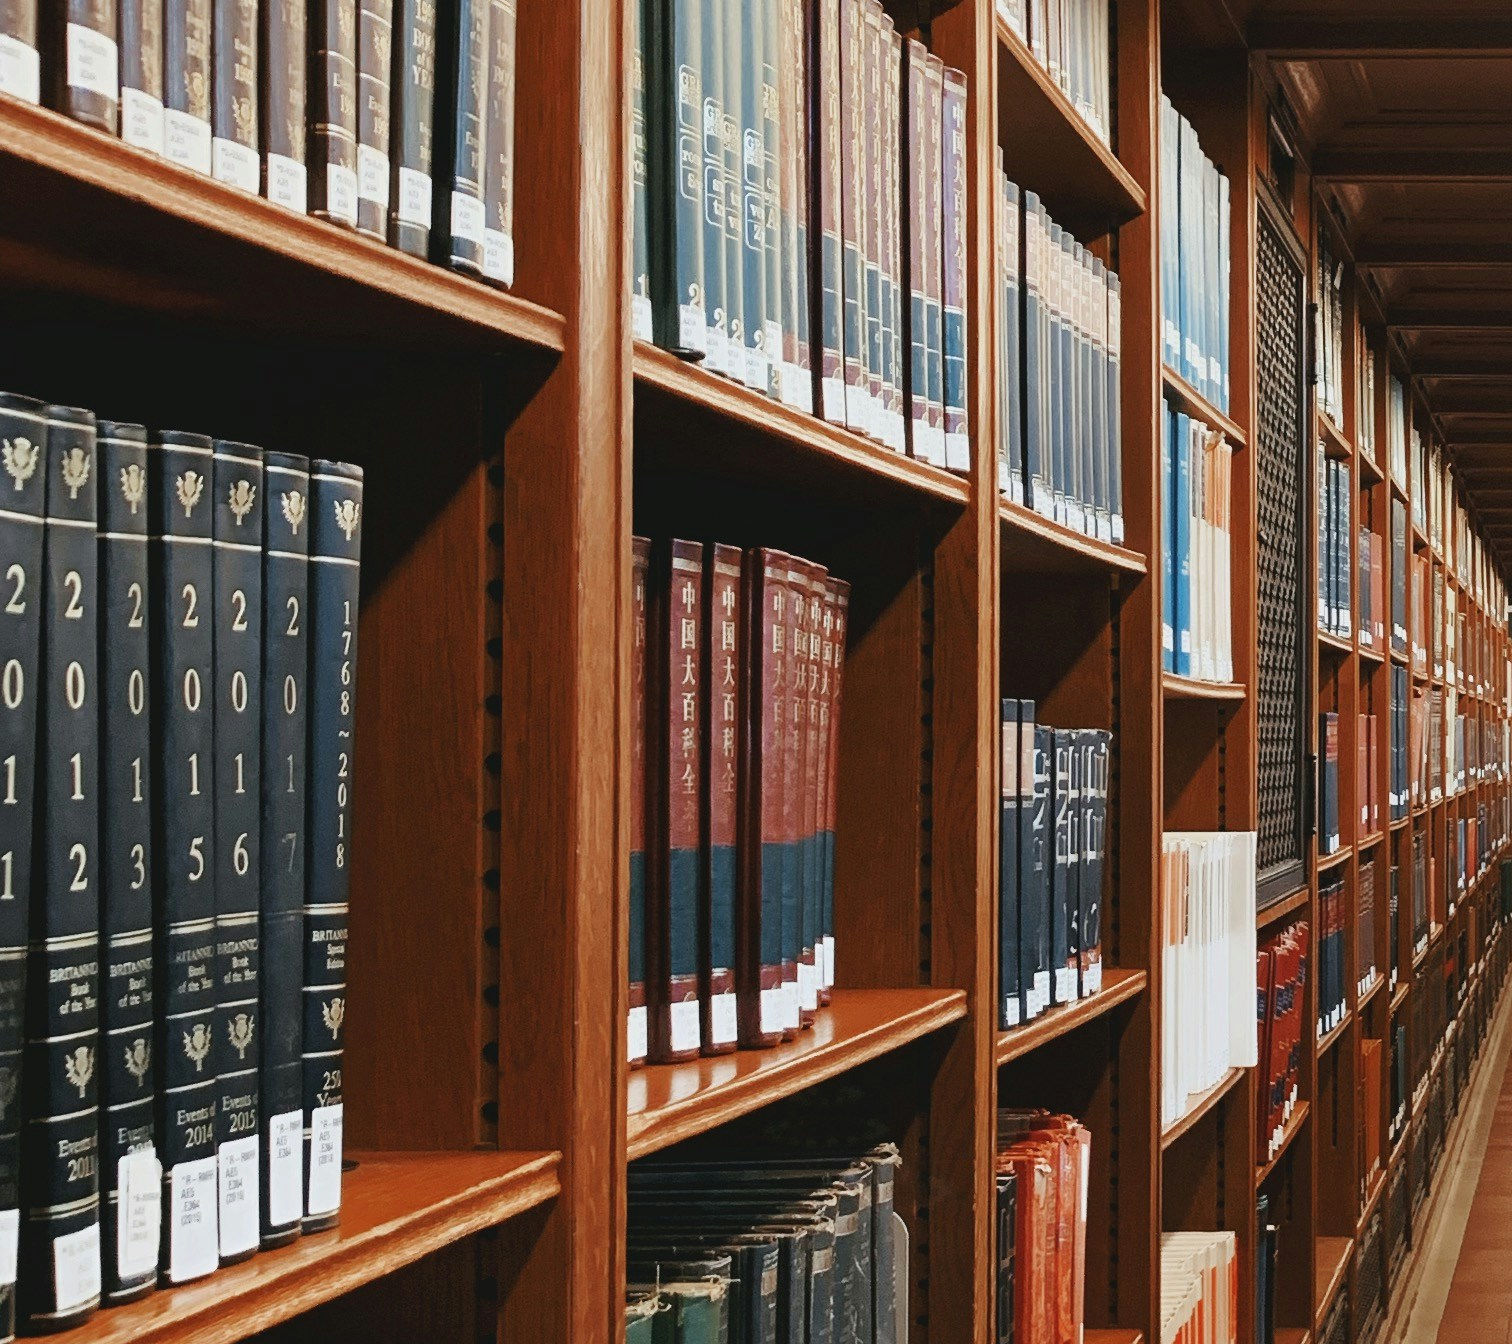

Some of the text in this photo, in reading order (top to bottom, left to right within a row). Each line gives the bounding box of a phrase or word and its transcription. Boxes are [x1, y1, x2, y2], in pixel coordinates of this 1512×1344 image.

[2, 563, 26, 900] 2011
[64, 570, 89, 893] 2012
[128, 582, 146, 890] 2013
[181, 584, 205, 881] 2015
[231, 590, 249, 876] 2016
[722, 585, 735, 796] 中国大百科全
[185, 1123, 214, 1149] 2014
[222, 1094, 252, 1112] Events
[229, 1108, 256, 1133] 2015
